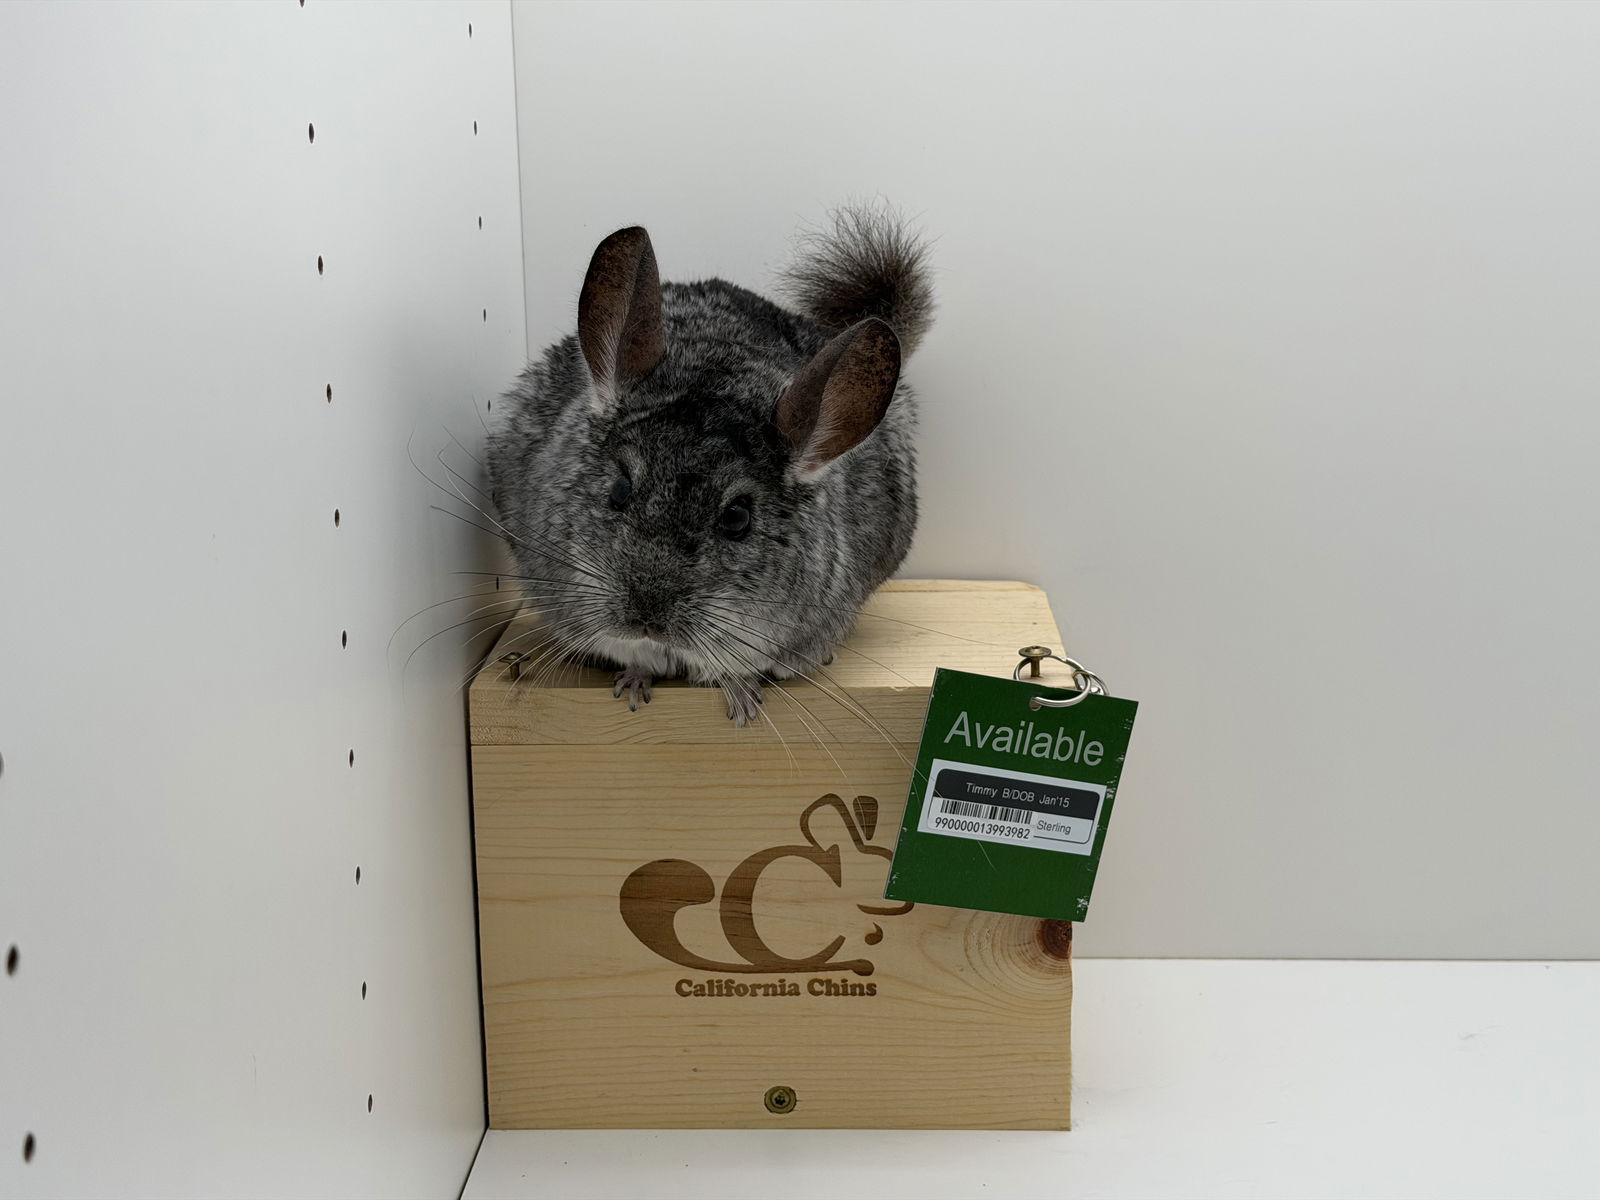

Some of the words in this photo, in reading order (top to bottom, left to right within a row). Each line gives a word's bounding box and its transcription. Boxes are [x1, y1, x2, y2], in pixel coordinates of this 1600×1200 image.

[944, 711, 1104, 766] Available
[966, 782, 997, 798] Timmy
[1002, 788, 1035, 802] B/DOB
[1039, 795, 1070, 808] Jan'15
[935, 817, 1030, 839] 990000013993982
[1037, 820, 1071, 835] Sterling
[675, 979, 800, 997] California
[806, 978, 877, 997] Chins
